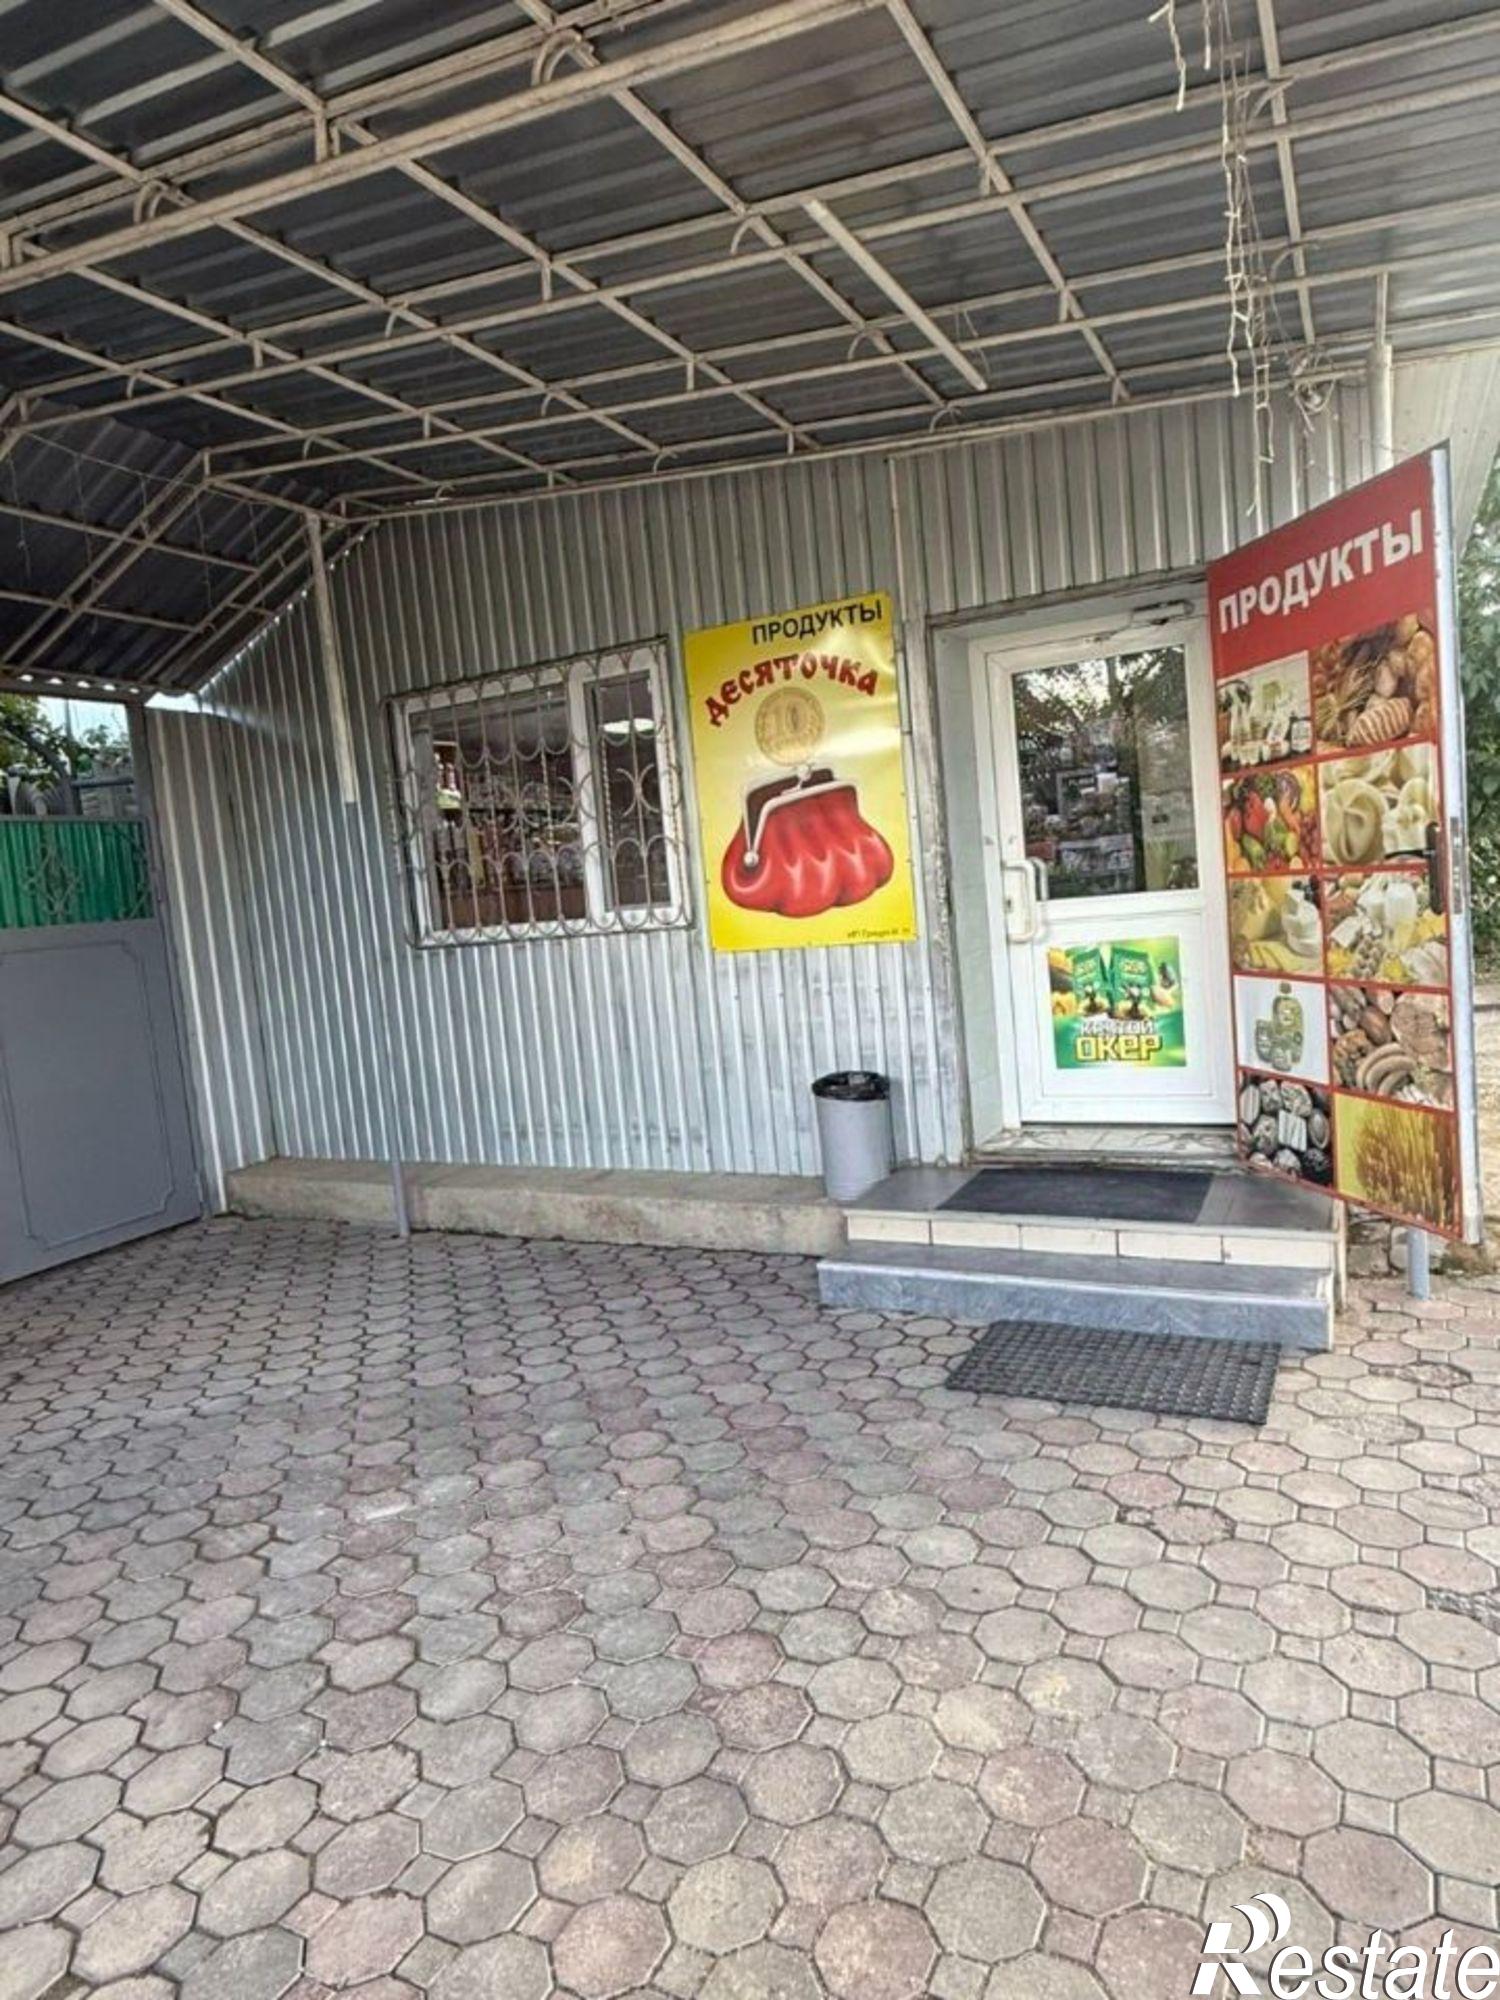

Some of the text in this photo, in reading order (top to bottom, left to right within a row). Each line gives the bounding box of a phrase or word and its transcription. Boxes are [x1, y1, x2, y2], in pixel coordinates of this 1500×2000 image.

[1218, 508, 1423, 634] ПРОДУКТЫ
[752, 600, 882, 645] ПРОДУКТЫ
[705, 652, 878, 727] ДЕСЯТОЧКА
